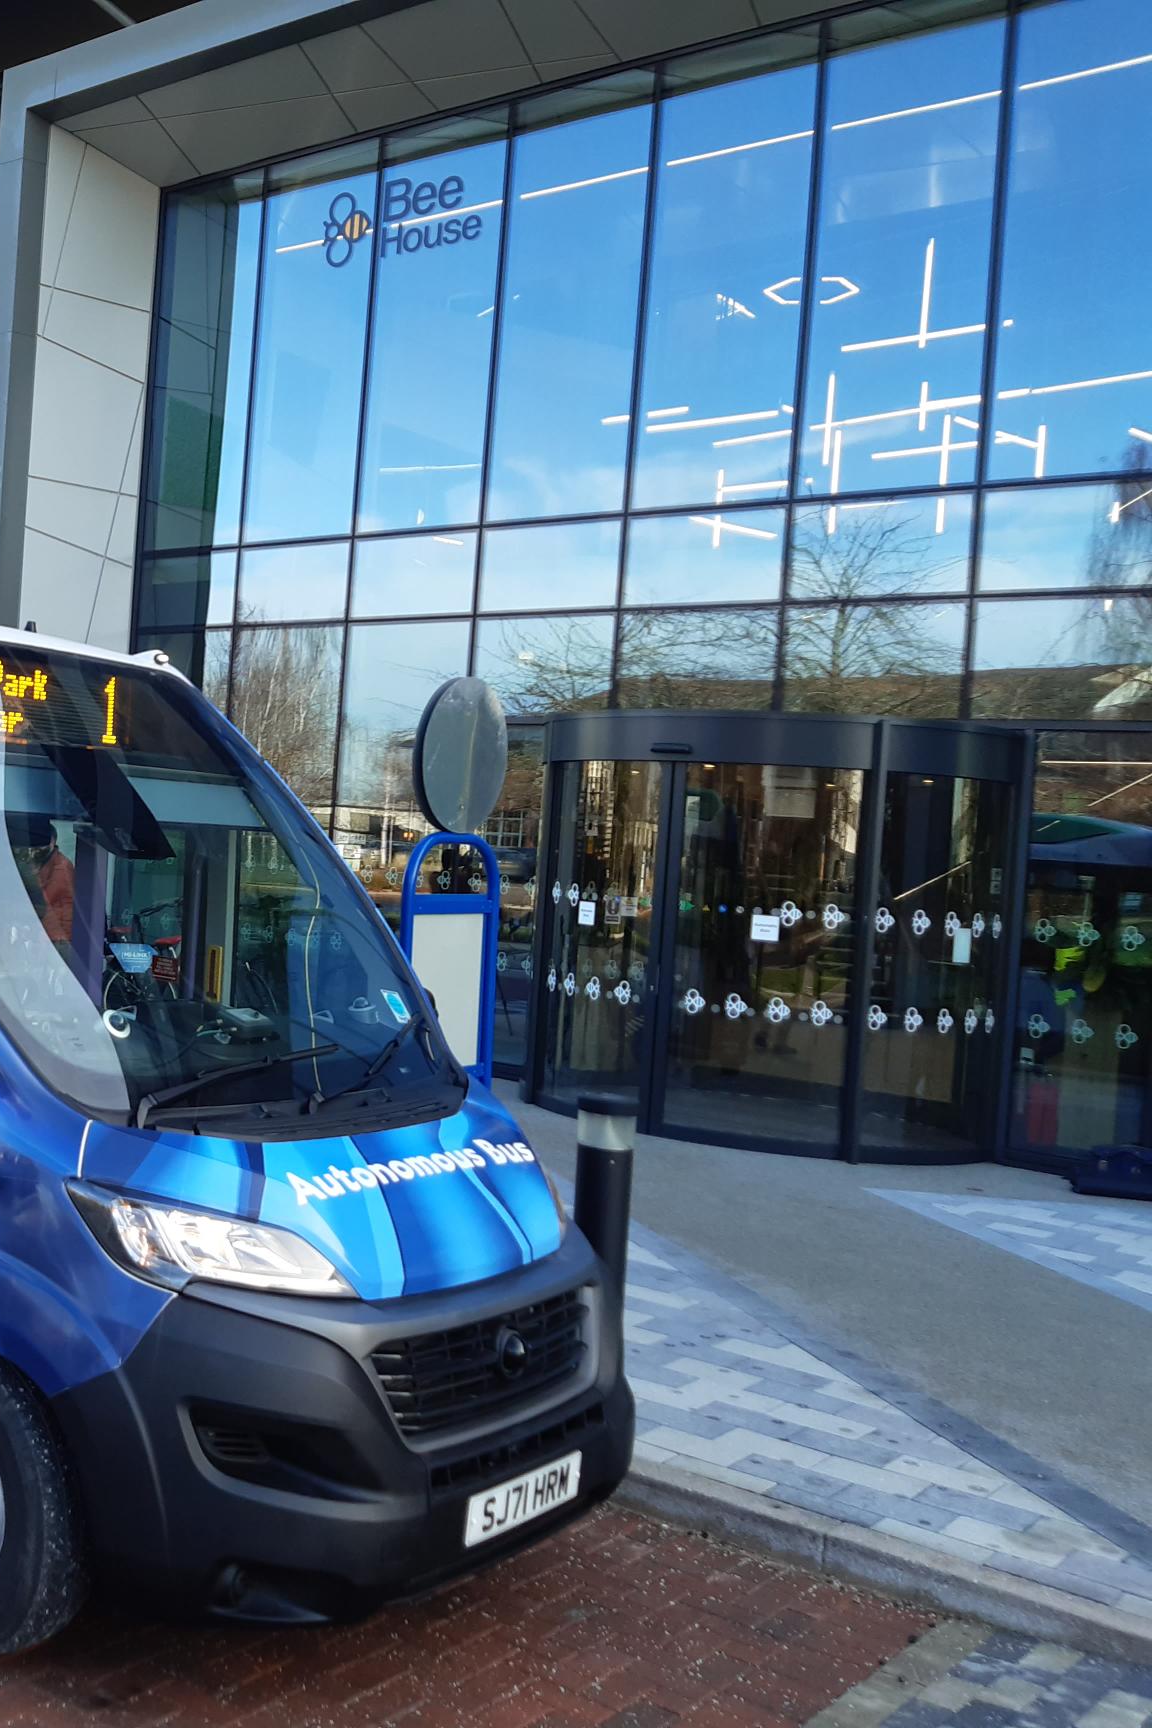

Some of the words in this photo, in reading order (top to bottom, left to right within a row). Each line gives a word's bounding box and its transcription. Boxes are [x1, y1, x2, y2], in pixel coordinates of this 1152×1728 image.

[383, 175, 465, 222] Bee
[380, 214, 482, 258] House
[101, 676, 117, 744] 1
[286, 1147, 486, 1206] Autonomous
[472, 1138, 536, 1165] Bus
[482, 1481, 529, 1532] SJ71
